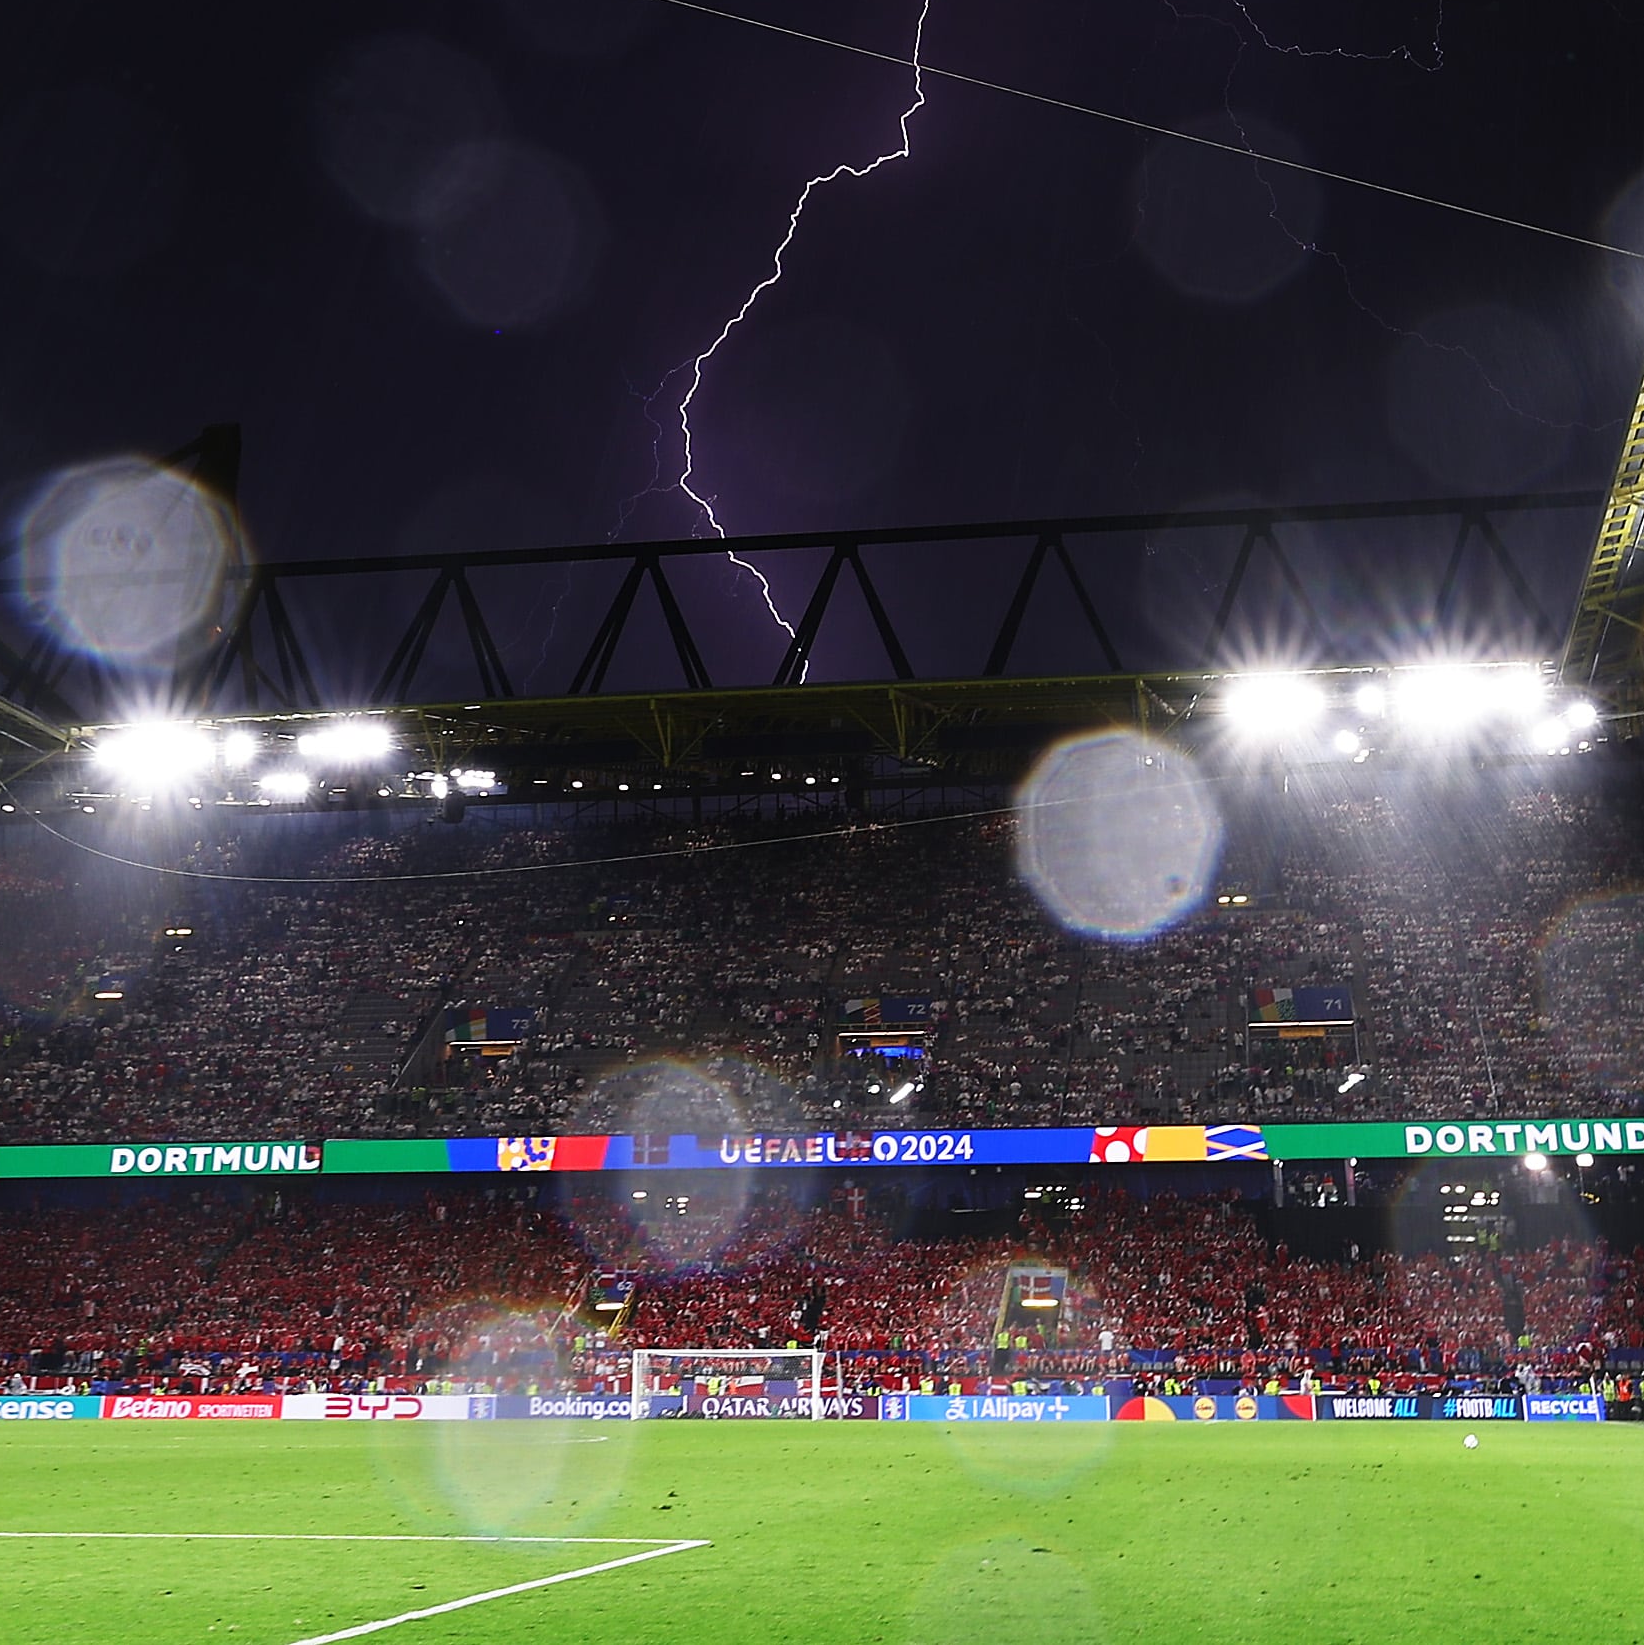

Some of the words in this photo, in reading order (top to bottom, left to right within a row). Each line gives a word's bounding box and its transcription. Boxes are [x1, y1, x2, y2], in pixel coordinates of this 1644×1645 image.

[907, 1004, 926, 1015] 72
[1323, 998, 1342, 1010] 71
[511, 1019, 529, 1029] 73
[720, 1134, 973, 1163] UEFAEUO2024
[111, 1397, 192, 1419] Betano
[324, 1397, 422, 1419] BYD
[701, 1397, 772, 1419] QATAR
[981, 1398, 1070, 1421] Alipay+
[1333, 1399, 1392, 1418] WELCOME
[1443, 1398, 1517, 1418] #FOOTBALL
[1530, 1398, 1596, 1415] RECYCLE
